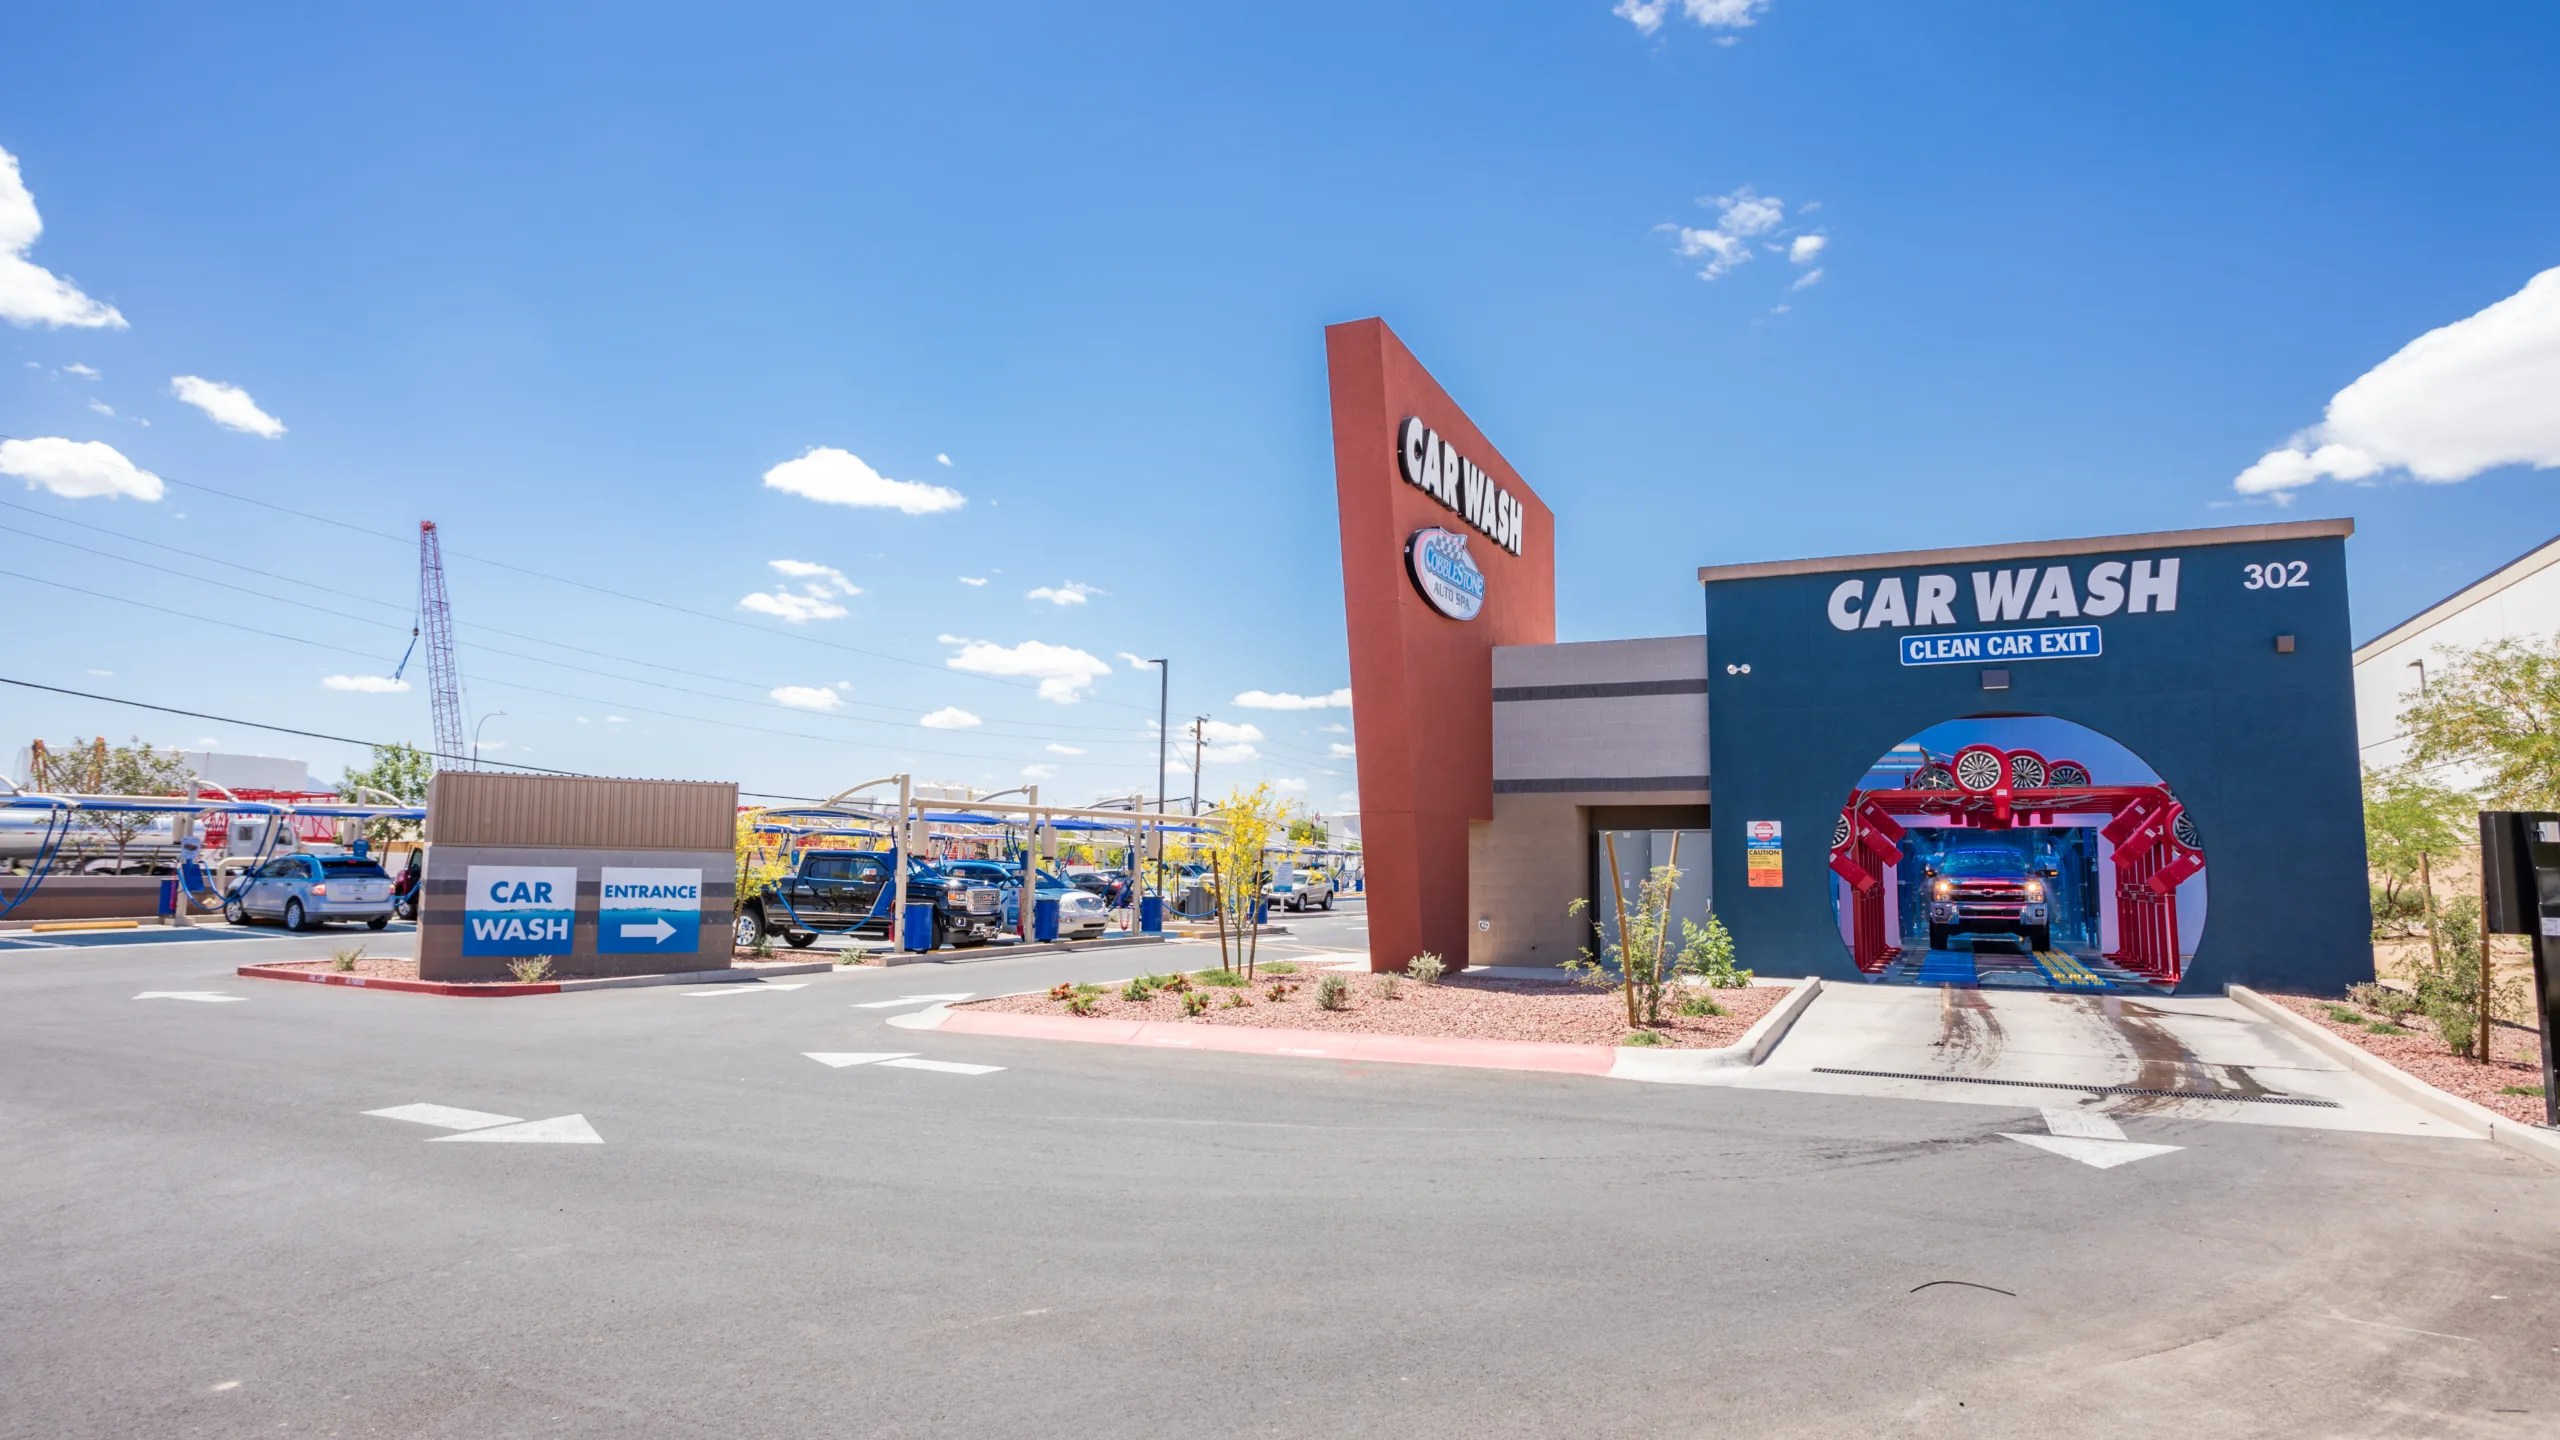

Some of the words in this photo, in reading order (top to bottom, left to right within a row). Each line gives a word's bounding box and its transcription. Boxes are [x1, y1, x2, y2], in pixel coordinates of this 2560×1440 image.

[1405, 416, 1459, 512] CAR
[1462, 456, 1523, 556] WASH
[2243, 560, 2310, 590] 302
[1433, 581, 1454, 602] AUTO
[1455, 593, 1471, 611] SPA
[1827, 574, 1957, 631] CAR
[1972, 558, 2181, 622] WASH
[1909, 637, 1980, 660] CLEAN
[1987, 635, 2033, 656] CAR
[2040, 631, 2091, 653] EXIT
[489, 880, 553, 903] CAR
[604, 884, 697, 899] ENTRANCE
[471, 918, 569, 941] WASH
